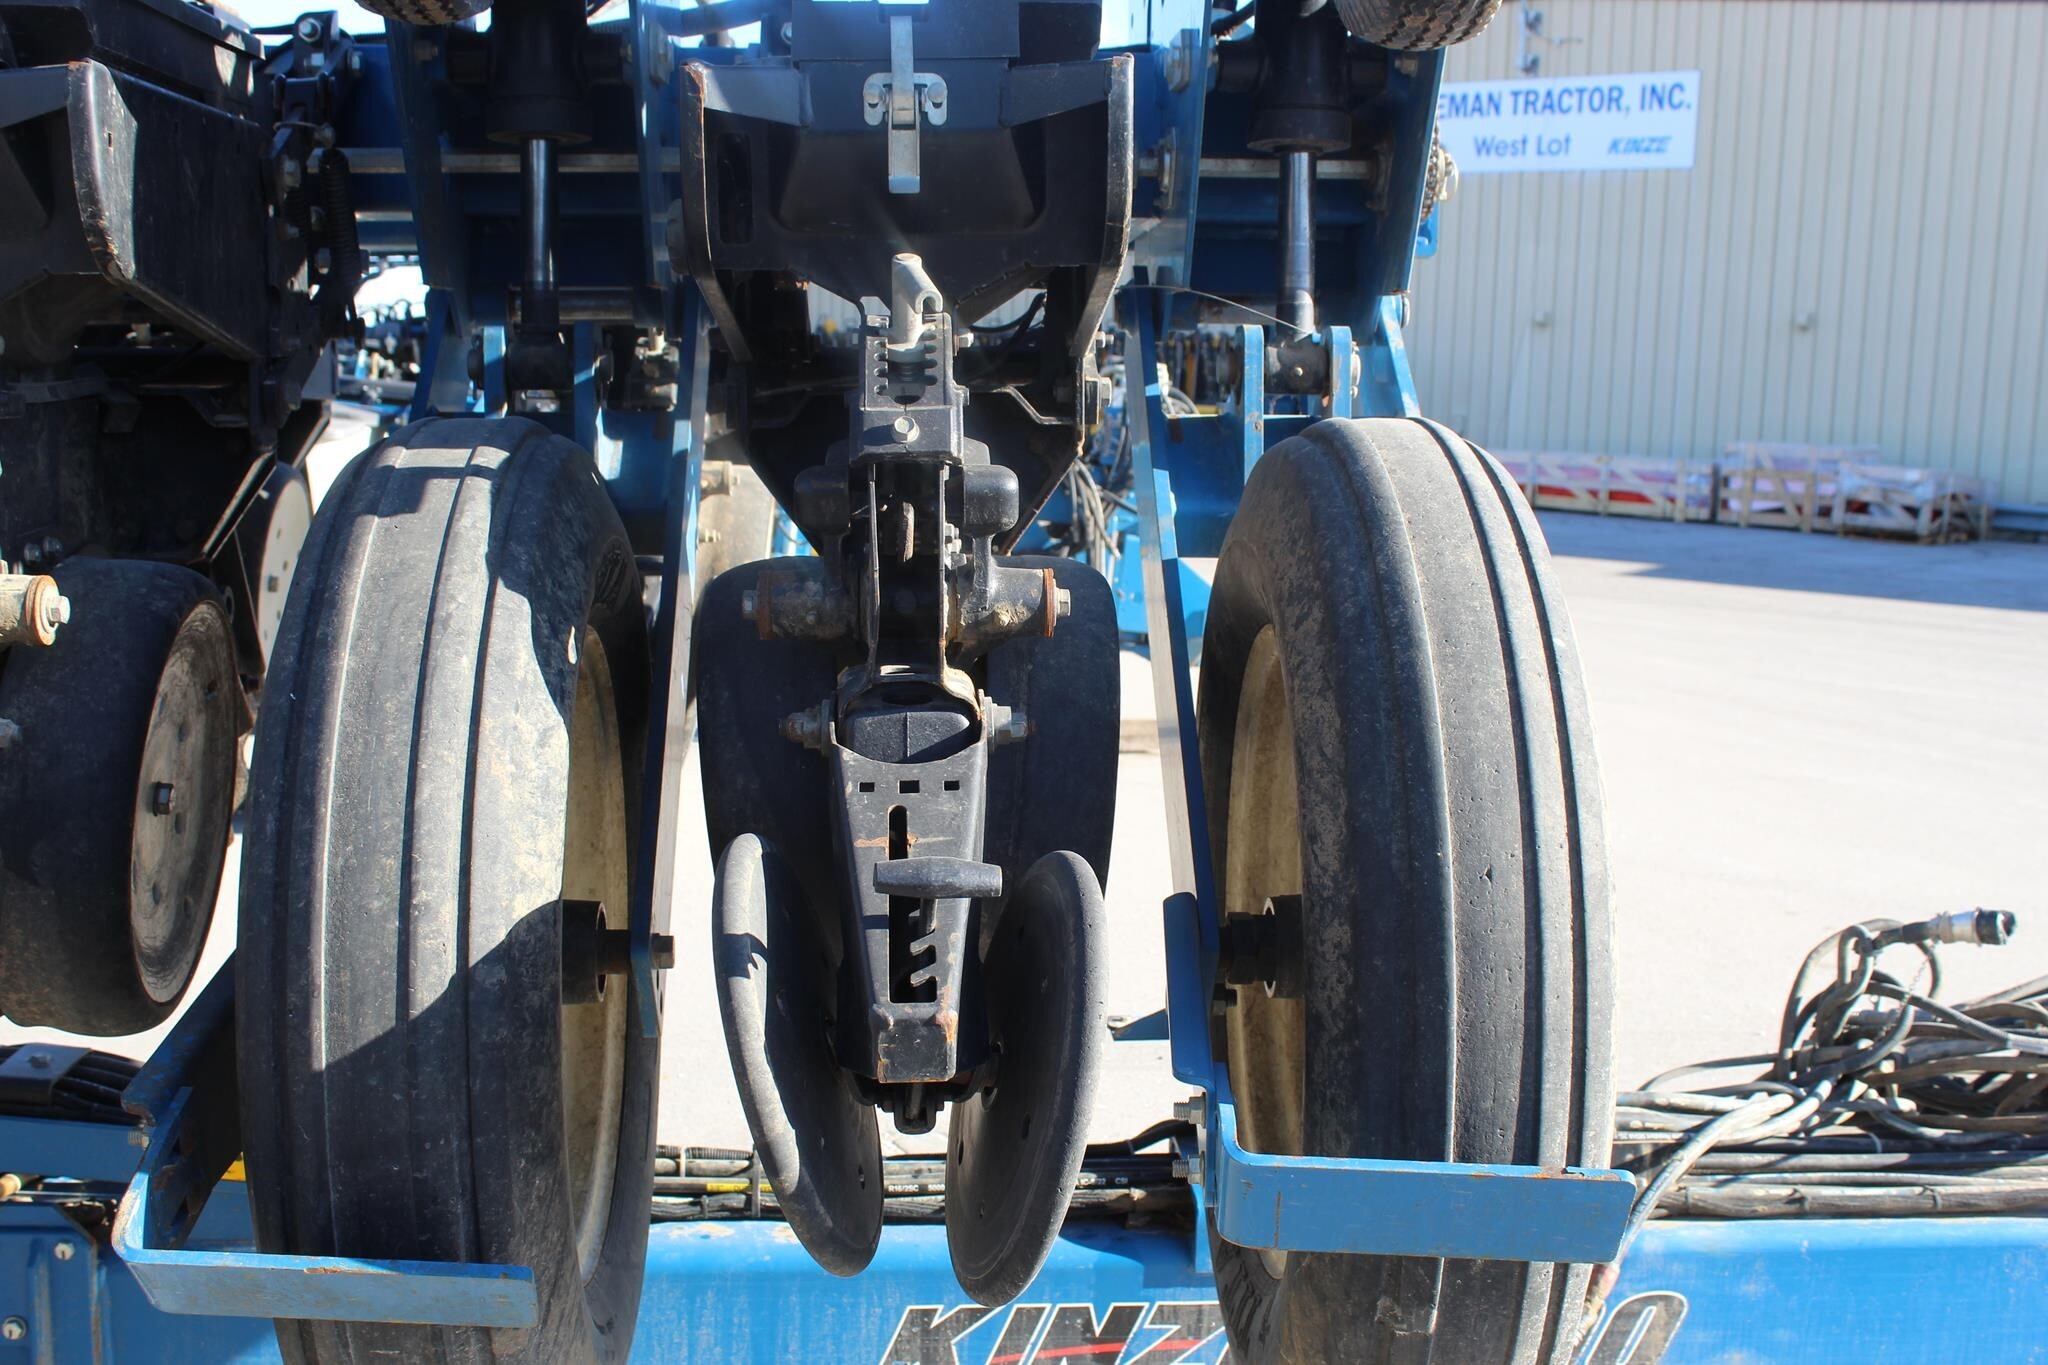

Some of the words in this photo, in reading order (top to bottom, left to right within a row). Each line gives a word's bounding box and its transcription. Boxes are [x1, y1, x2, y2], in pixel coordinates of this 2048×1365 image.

[1510, 86, 1631, 118] TRACTOR,
[1640, 82, 1693, 112] INC.
[1474, 134, 1528, 157] West
[1536, 134, 1571, 157] Lot
[877, 1301, 1230, 1365] KINZ
